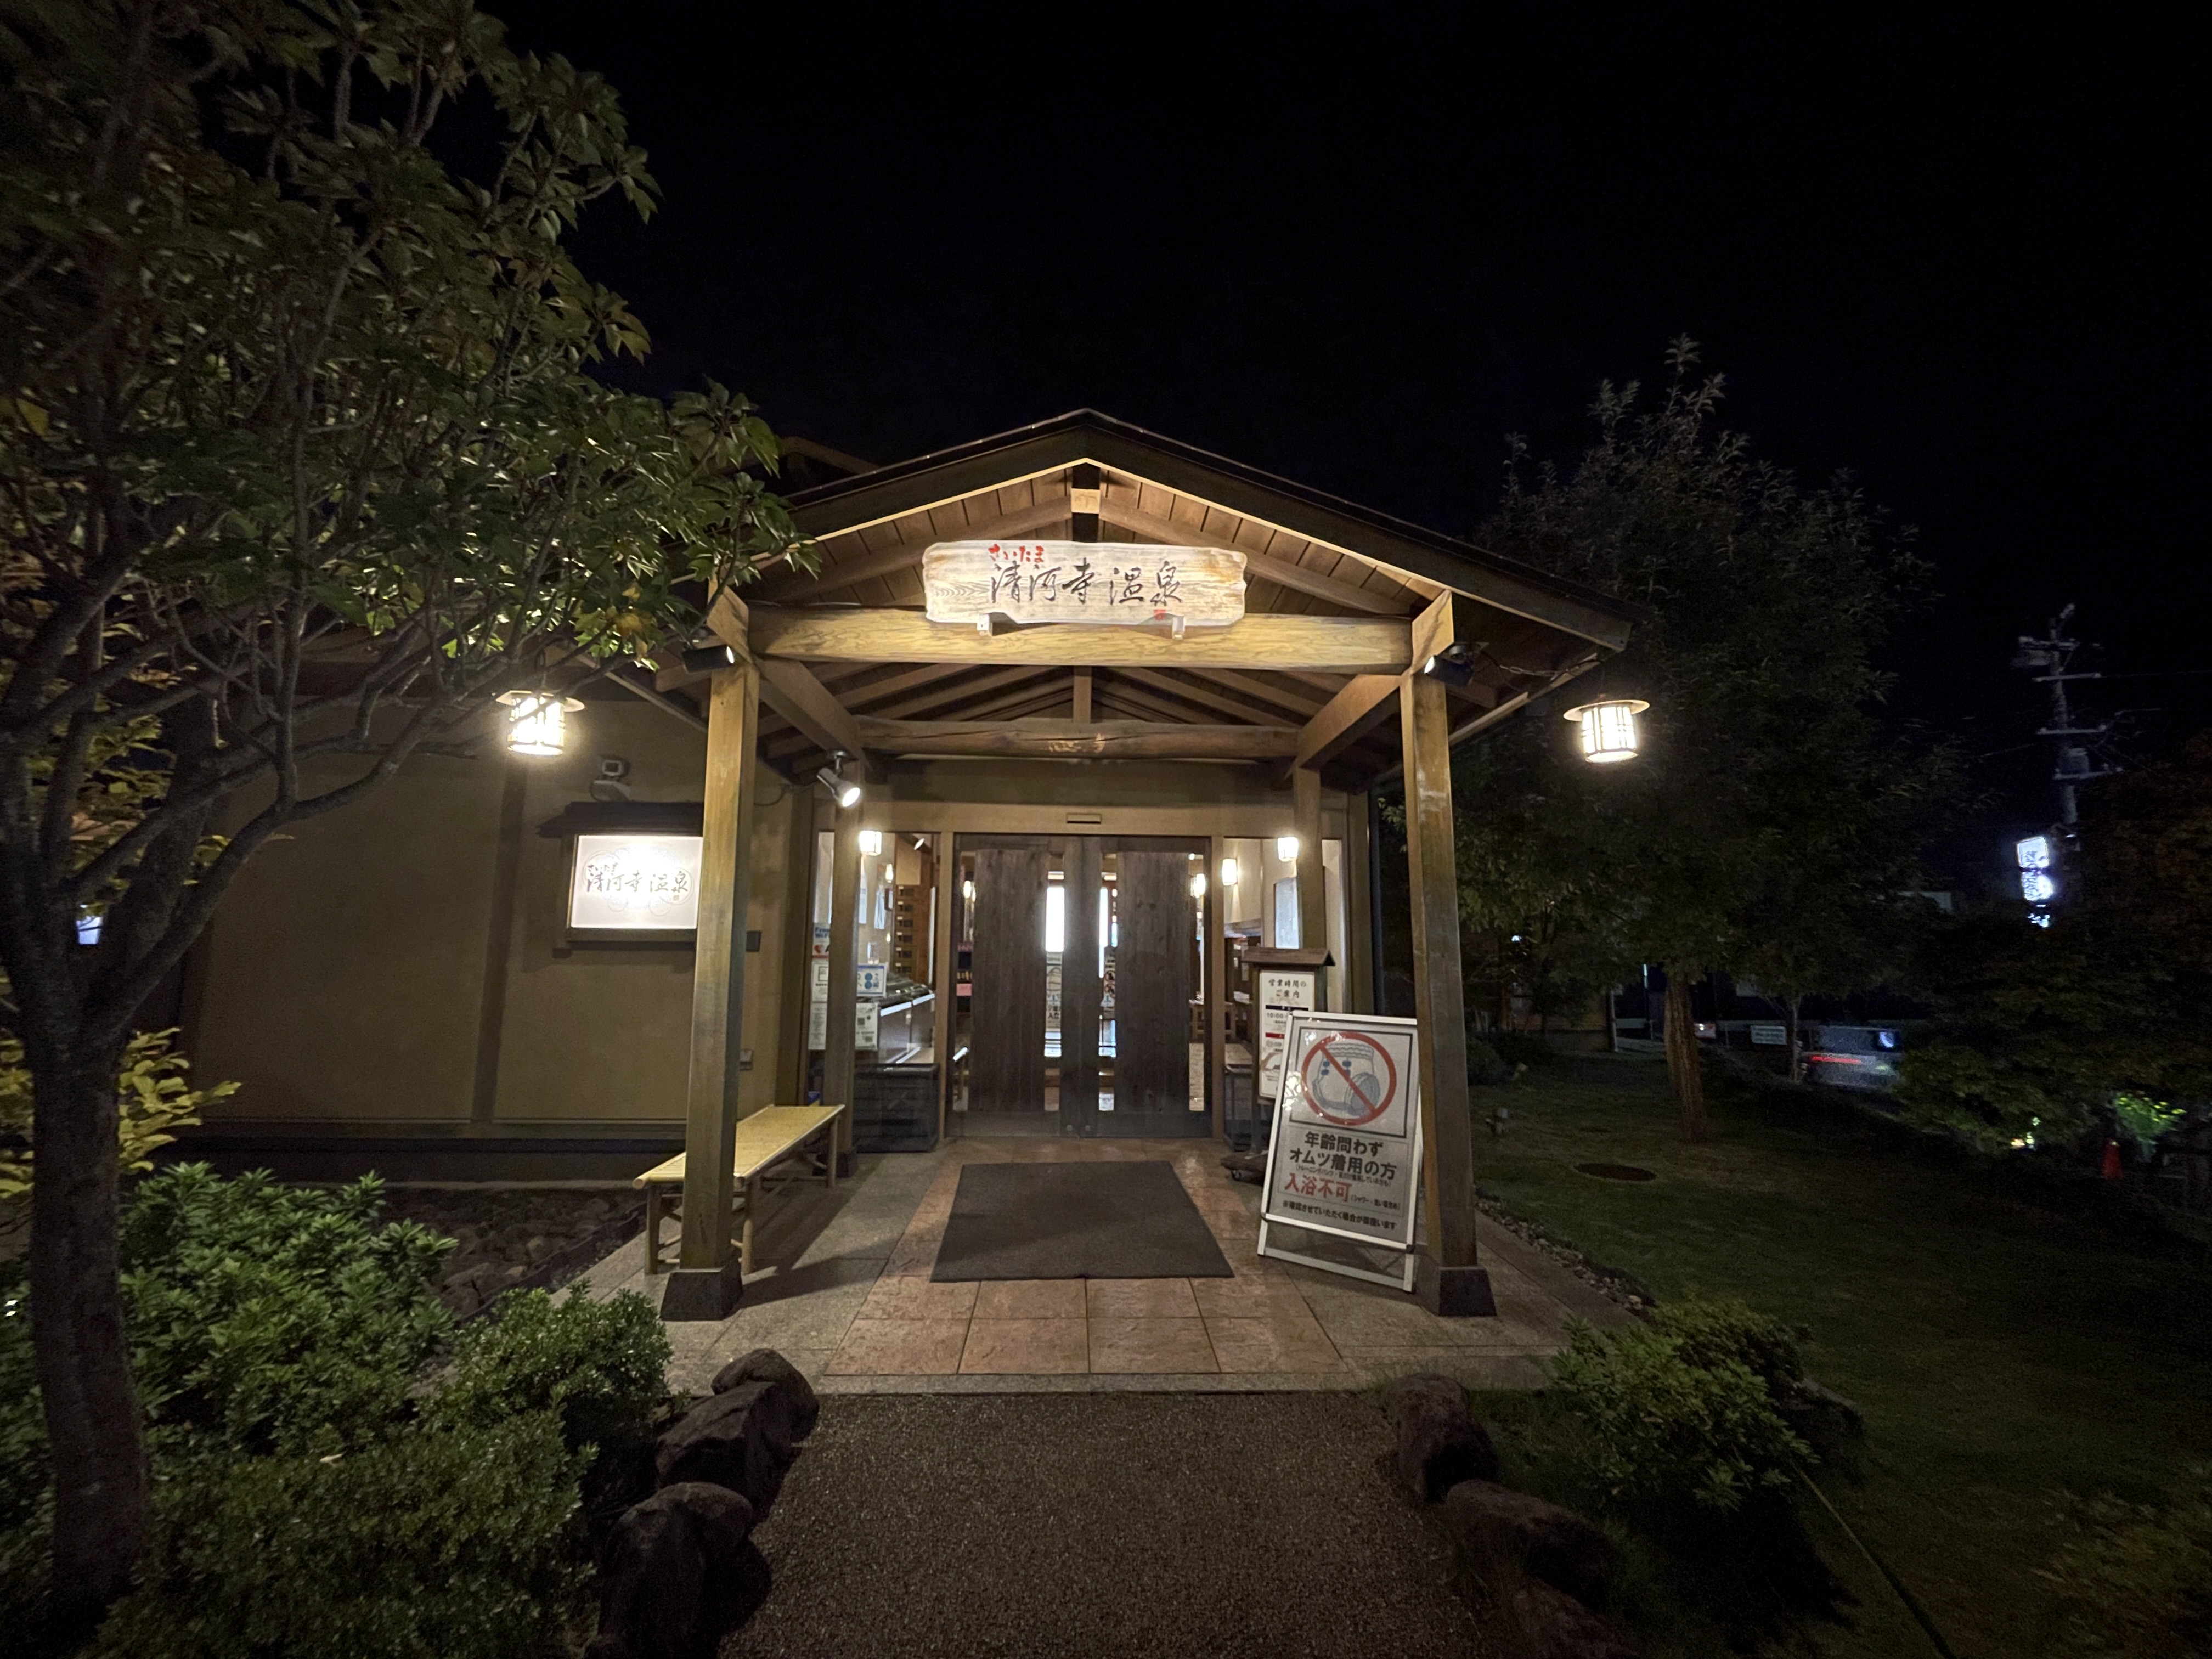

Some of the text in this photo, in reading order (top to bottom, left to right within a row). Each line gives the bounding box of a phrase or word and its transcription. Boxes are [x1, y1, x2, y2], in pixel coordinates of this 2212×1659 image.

[988, 543, 1044, 562] さいたま
[991, 557, 1182, 606] 清河寺温泉
[586, 870, 688, 893] 清河寺温泉
[1268, 979, 1306, 988] 営業時間の
[1304, 1131, 1383, 1156] 年齢問わず
[1290, 1148, 1397, 1180] オムツ着用の方
[1284, 1173, 1352, 1202] 入浴不可
